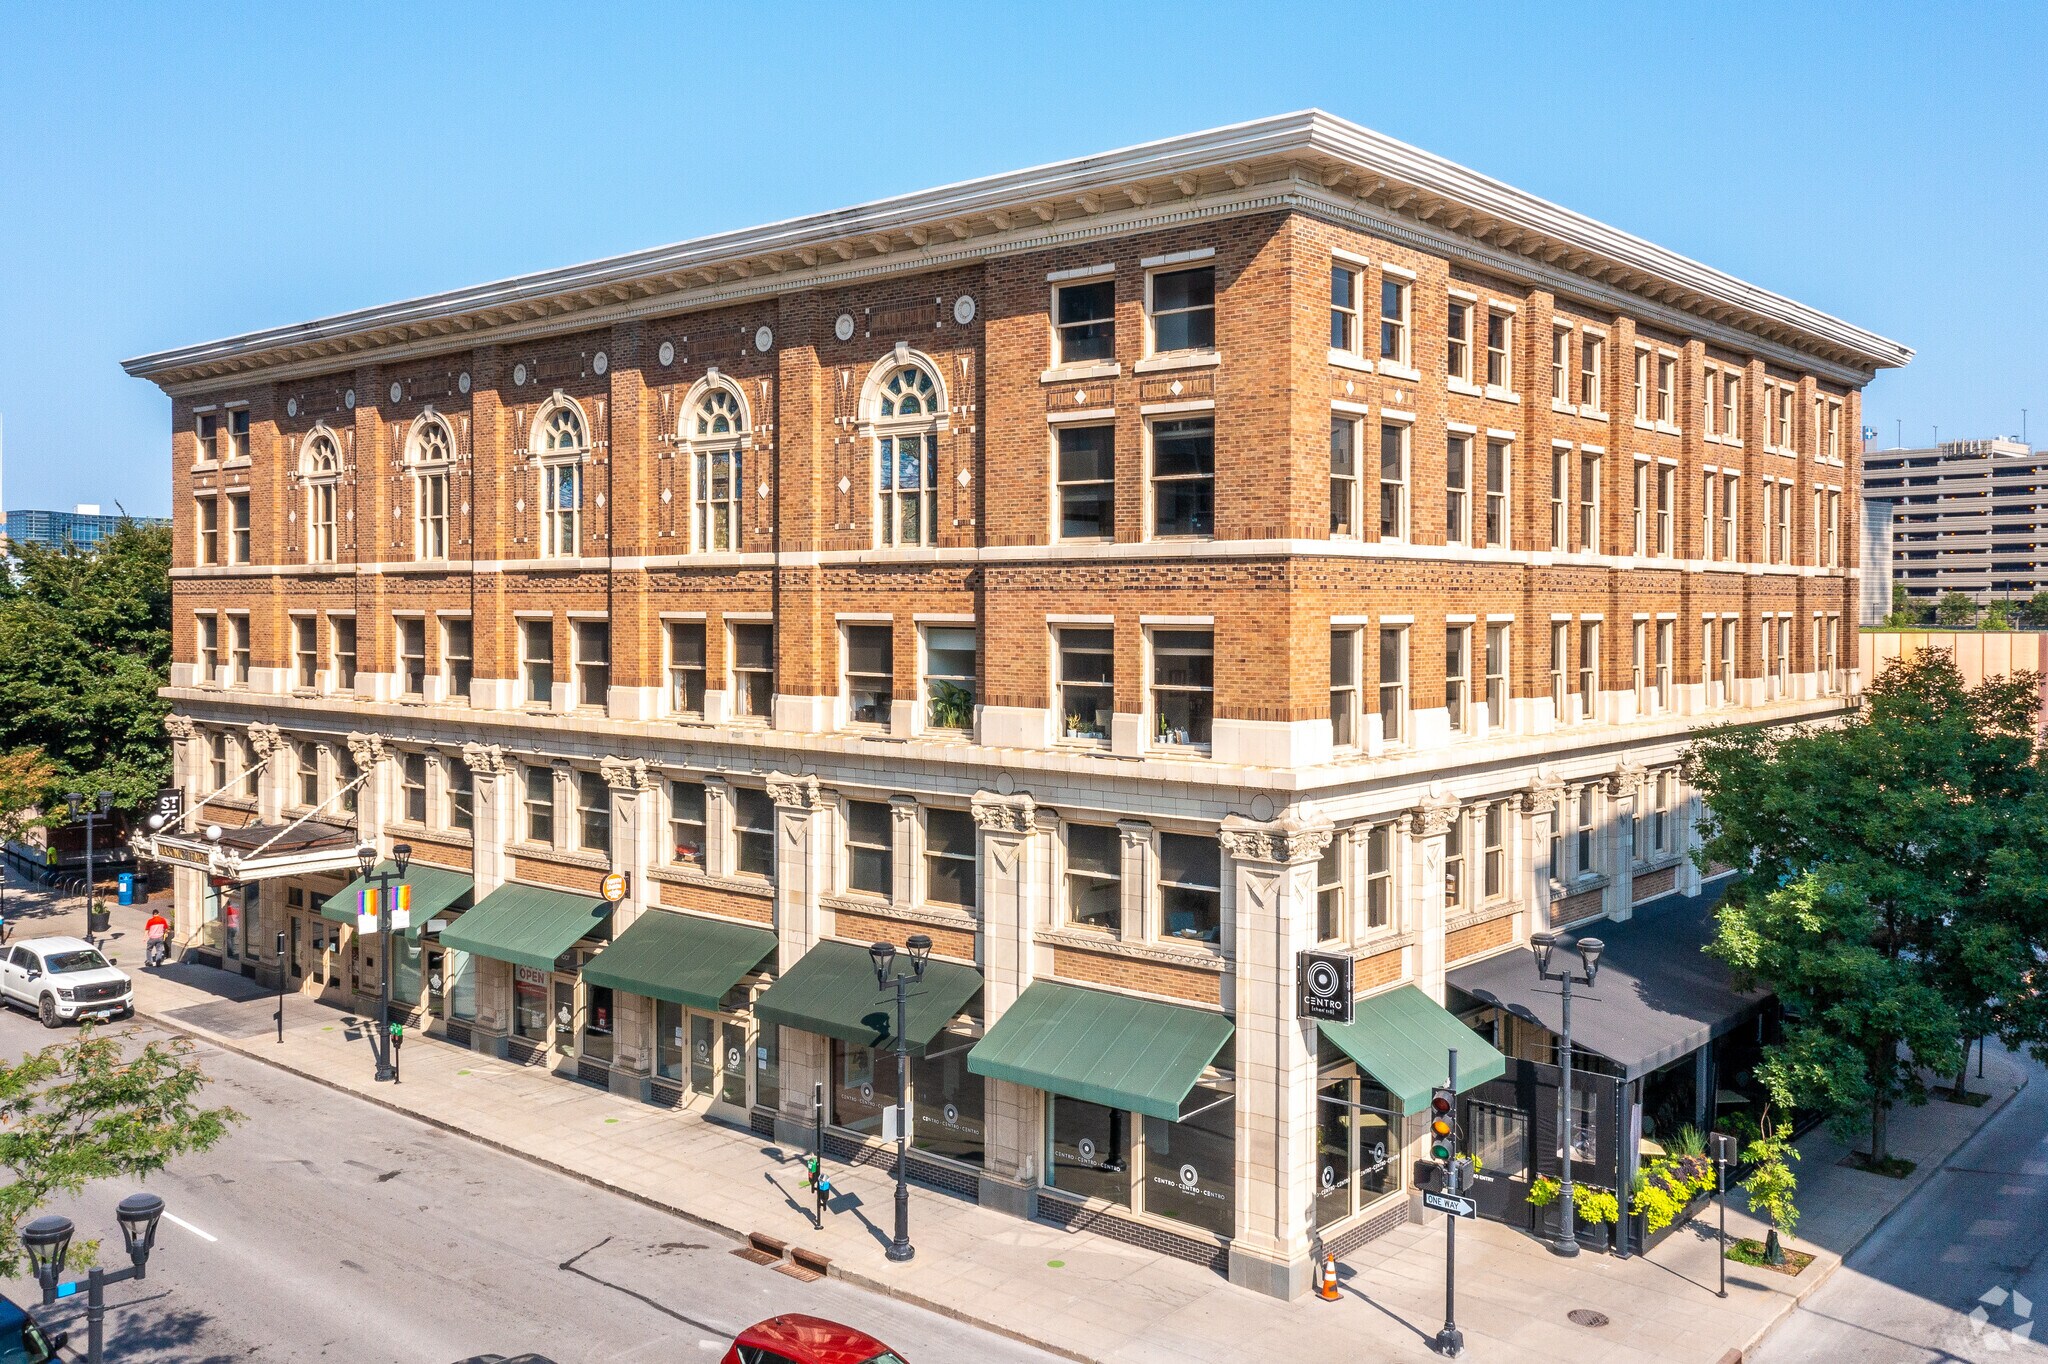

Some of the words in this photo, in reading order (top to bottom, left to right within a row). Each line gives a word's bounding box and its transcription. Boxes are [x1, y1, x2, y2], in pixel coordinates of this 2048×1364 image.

[519, 968, 545, 984] OPEN
[1304, 996, 1342, 1009] CENTRO
[841, 1093, 857, 1102] CENTRO
[860, 1098, 876, 1107] CENTRO
[922, 1115, 940, 1125] CENTRO
[942, 1121, 960, 1130] CENTRO
[961, 1126, 980, 1136] CENTRO
[1054, 1150, 1075, 1160] CENTRO
[1077, 1156, 1098, 1166] CENTRO
[1100, 1162, 1121, 1173] CENTRO
[1479, 1174, 1494, 1183] ENTRY
[1154, 1176, 1176, 1187] CENTRO
[1178, 1183, 1200, 1194] CENTRO
[1203, 1189, 1226, 1200] CENTRO
[1427, 1195, 1442, 1206] ONE
[1443, 1200, 1460, 1210] WAY
